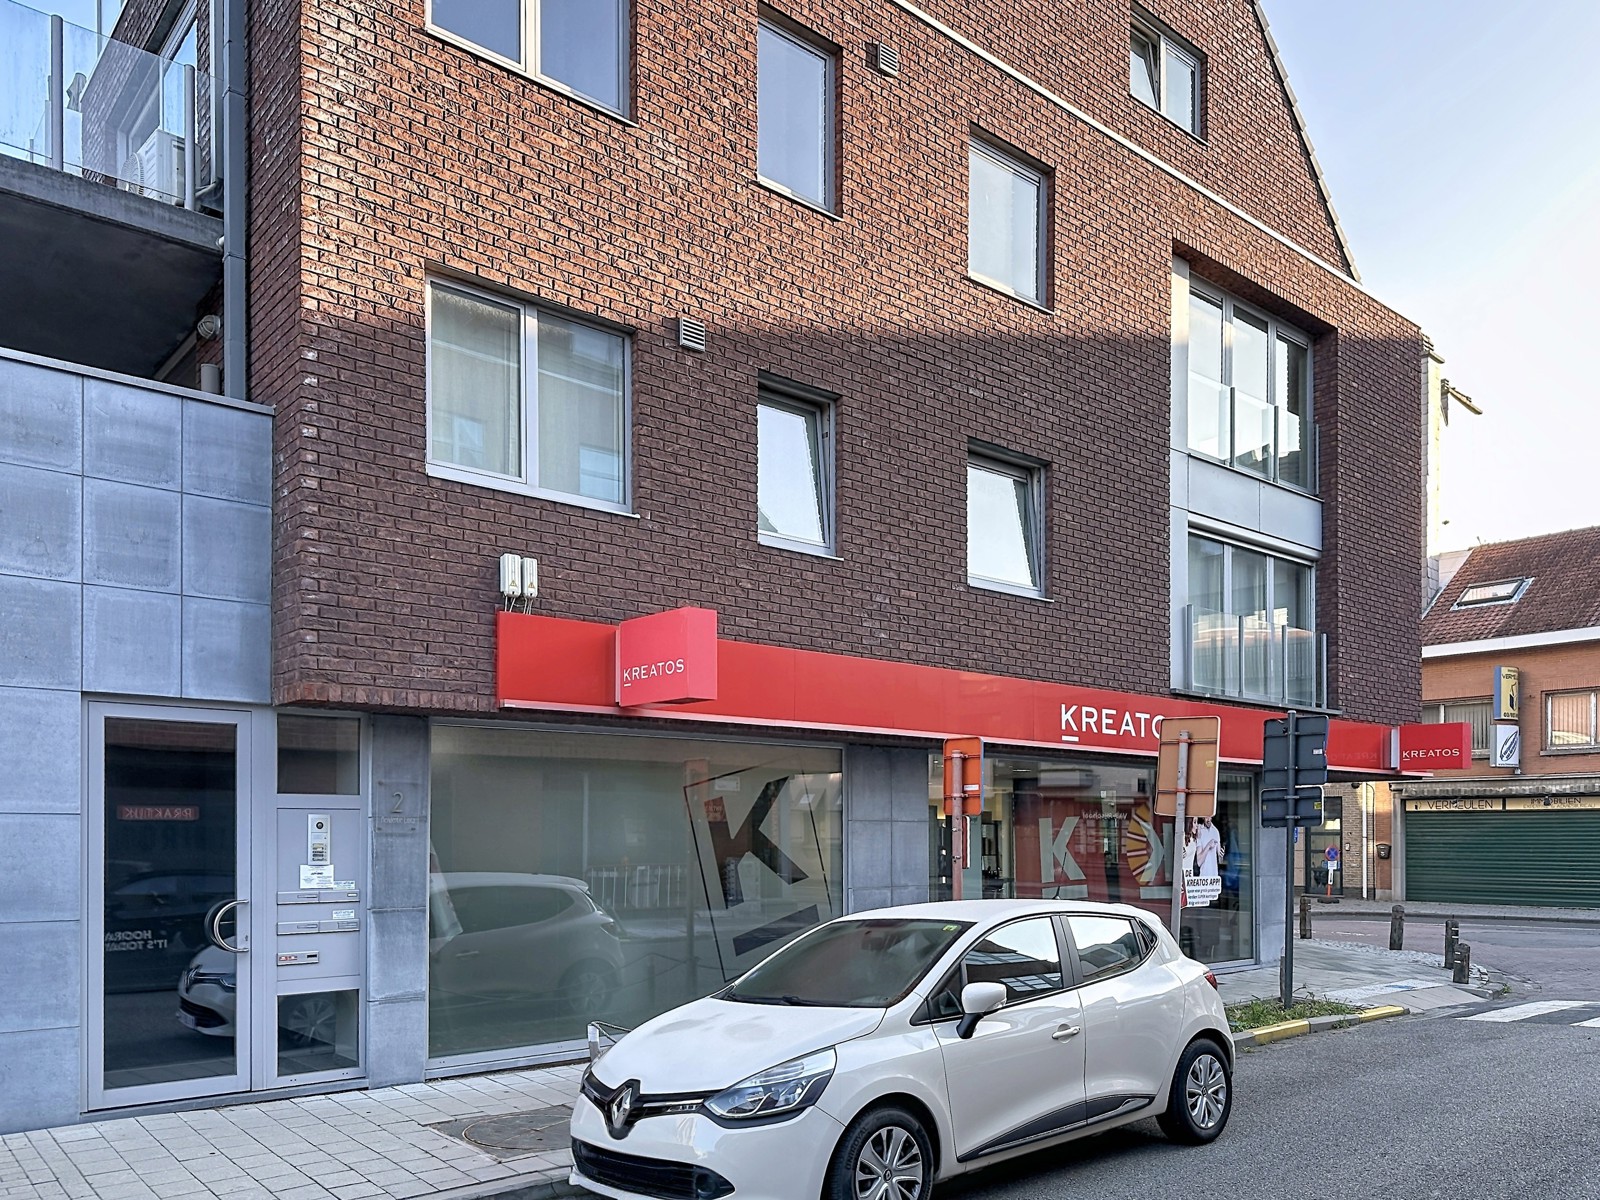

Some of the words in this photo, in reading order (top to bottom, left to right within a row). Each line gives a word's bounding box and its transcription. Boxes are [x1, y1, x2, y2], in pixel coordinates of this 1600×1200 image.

[623, 658, 685, 682] KREATOS
[1402, 748, 1460, 759] KREATOS
[391, 791, 404, 814] 2
[1185, 869, 1192, 877] DE
[1187, 878, 1208, 887] KREATOS
[1210, 878, 1221, 886] APP!
